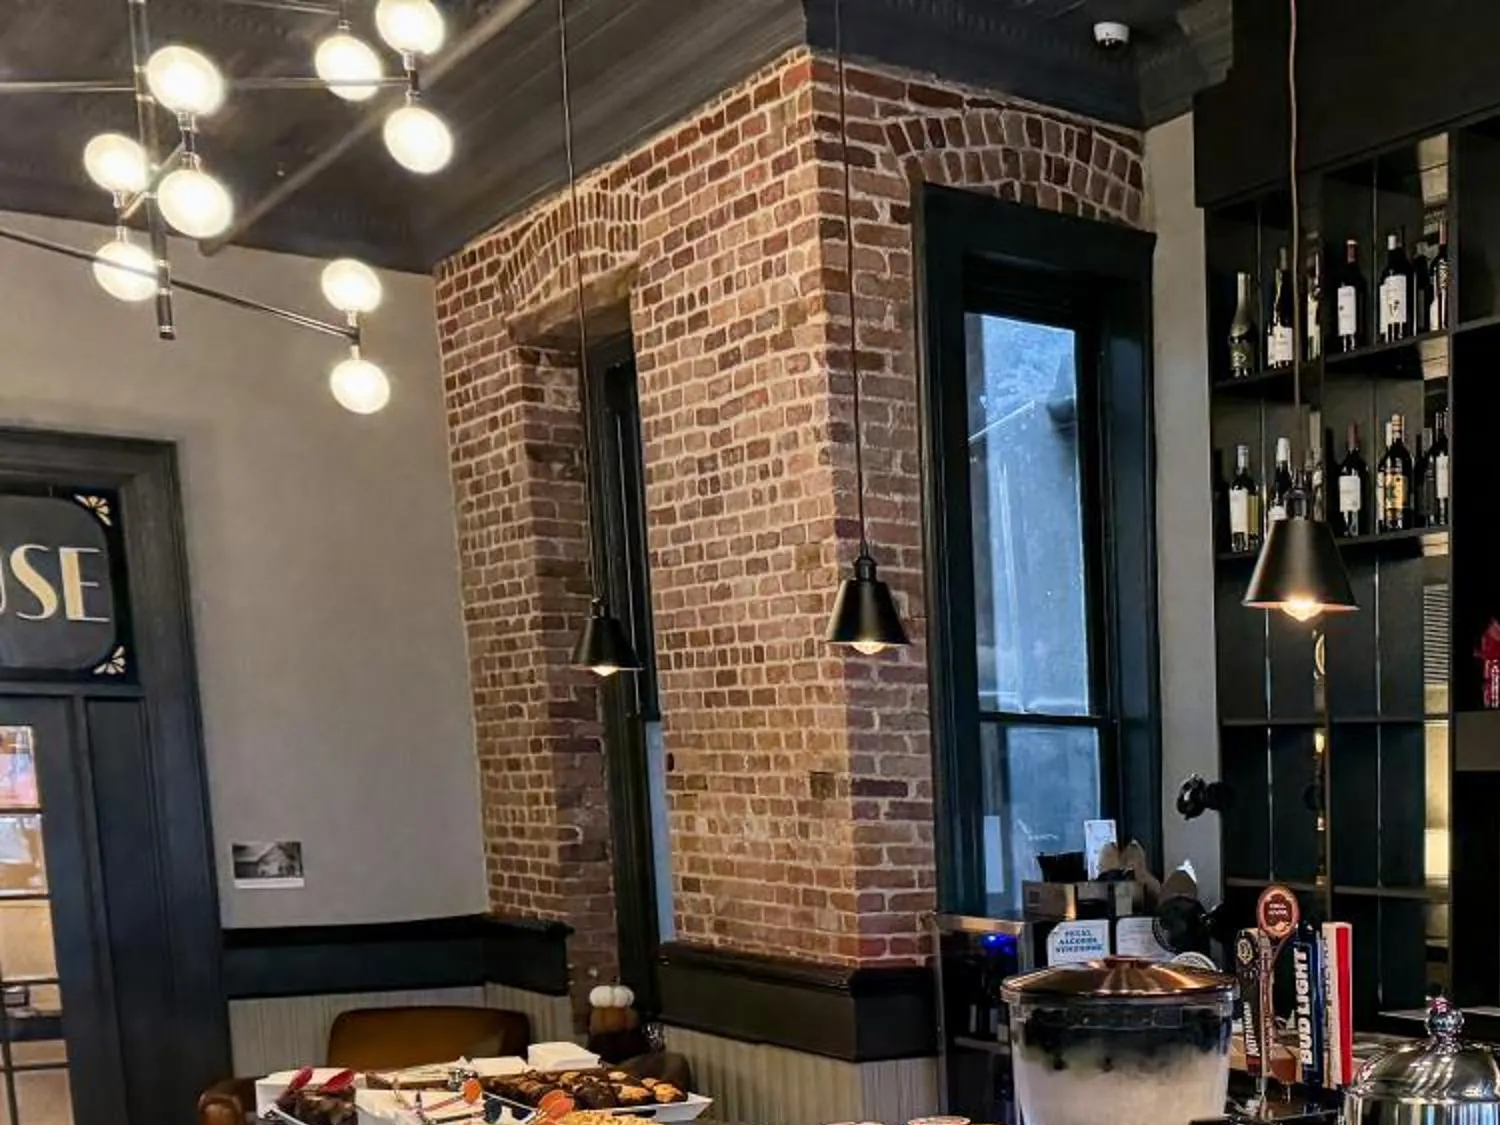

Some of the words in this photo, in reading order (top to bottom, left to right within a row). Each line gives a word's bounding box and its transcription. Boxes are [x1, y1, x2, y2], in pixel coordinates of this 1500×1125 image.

[0, 543, 111, 622] SE
[1293, 946, 1311, 1016] LIGHT
[1298, 1017, 1313, 1065] BUD
